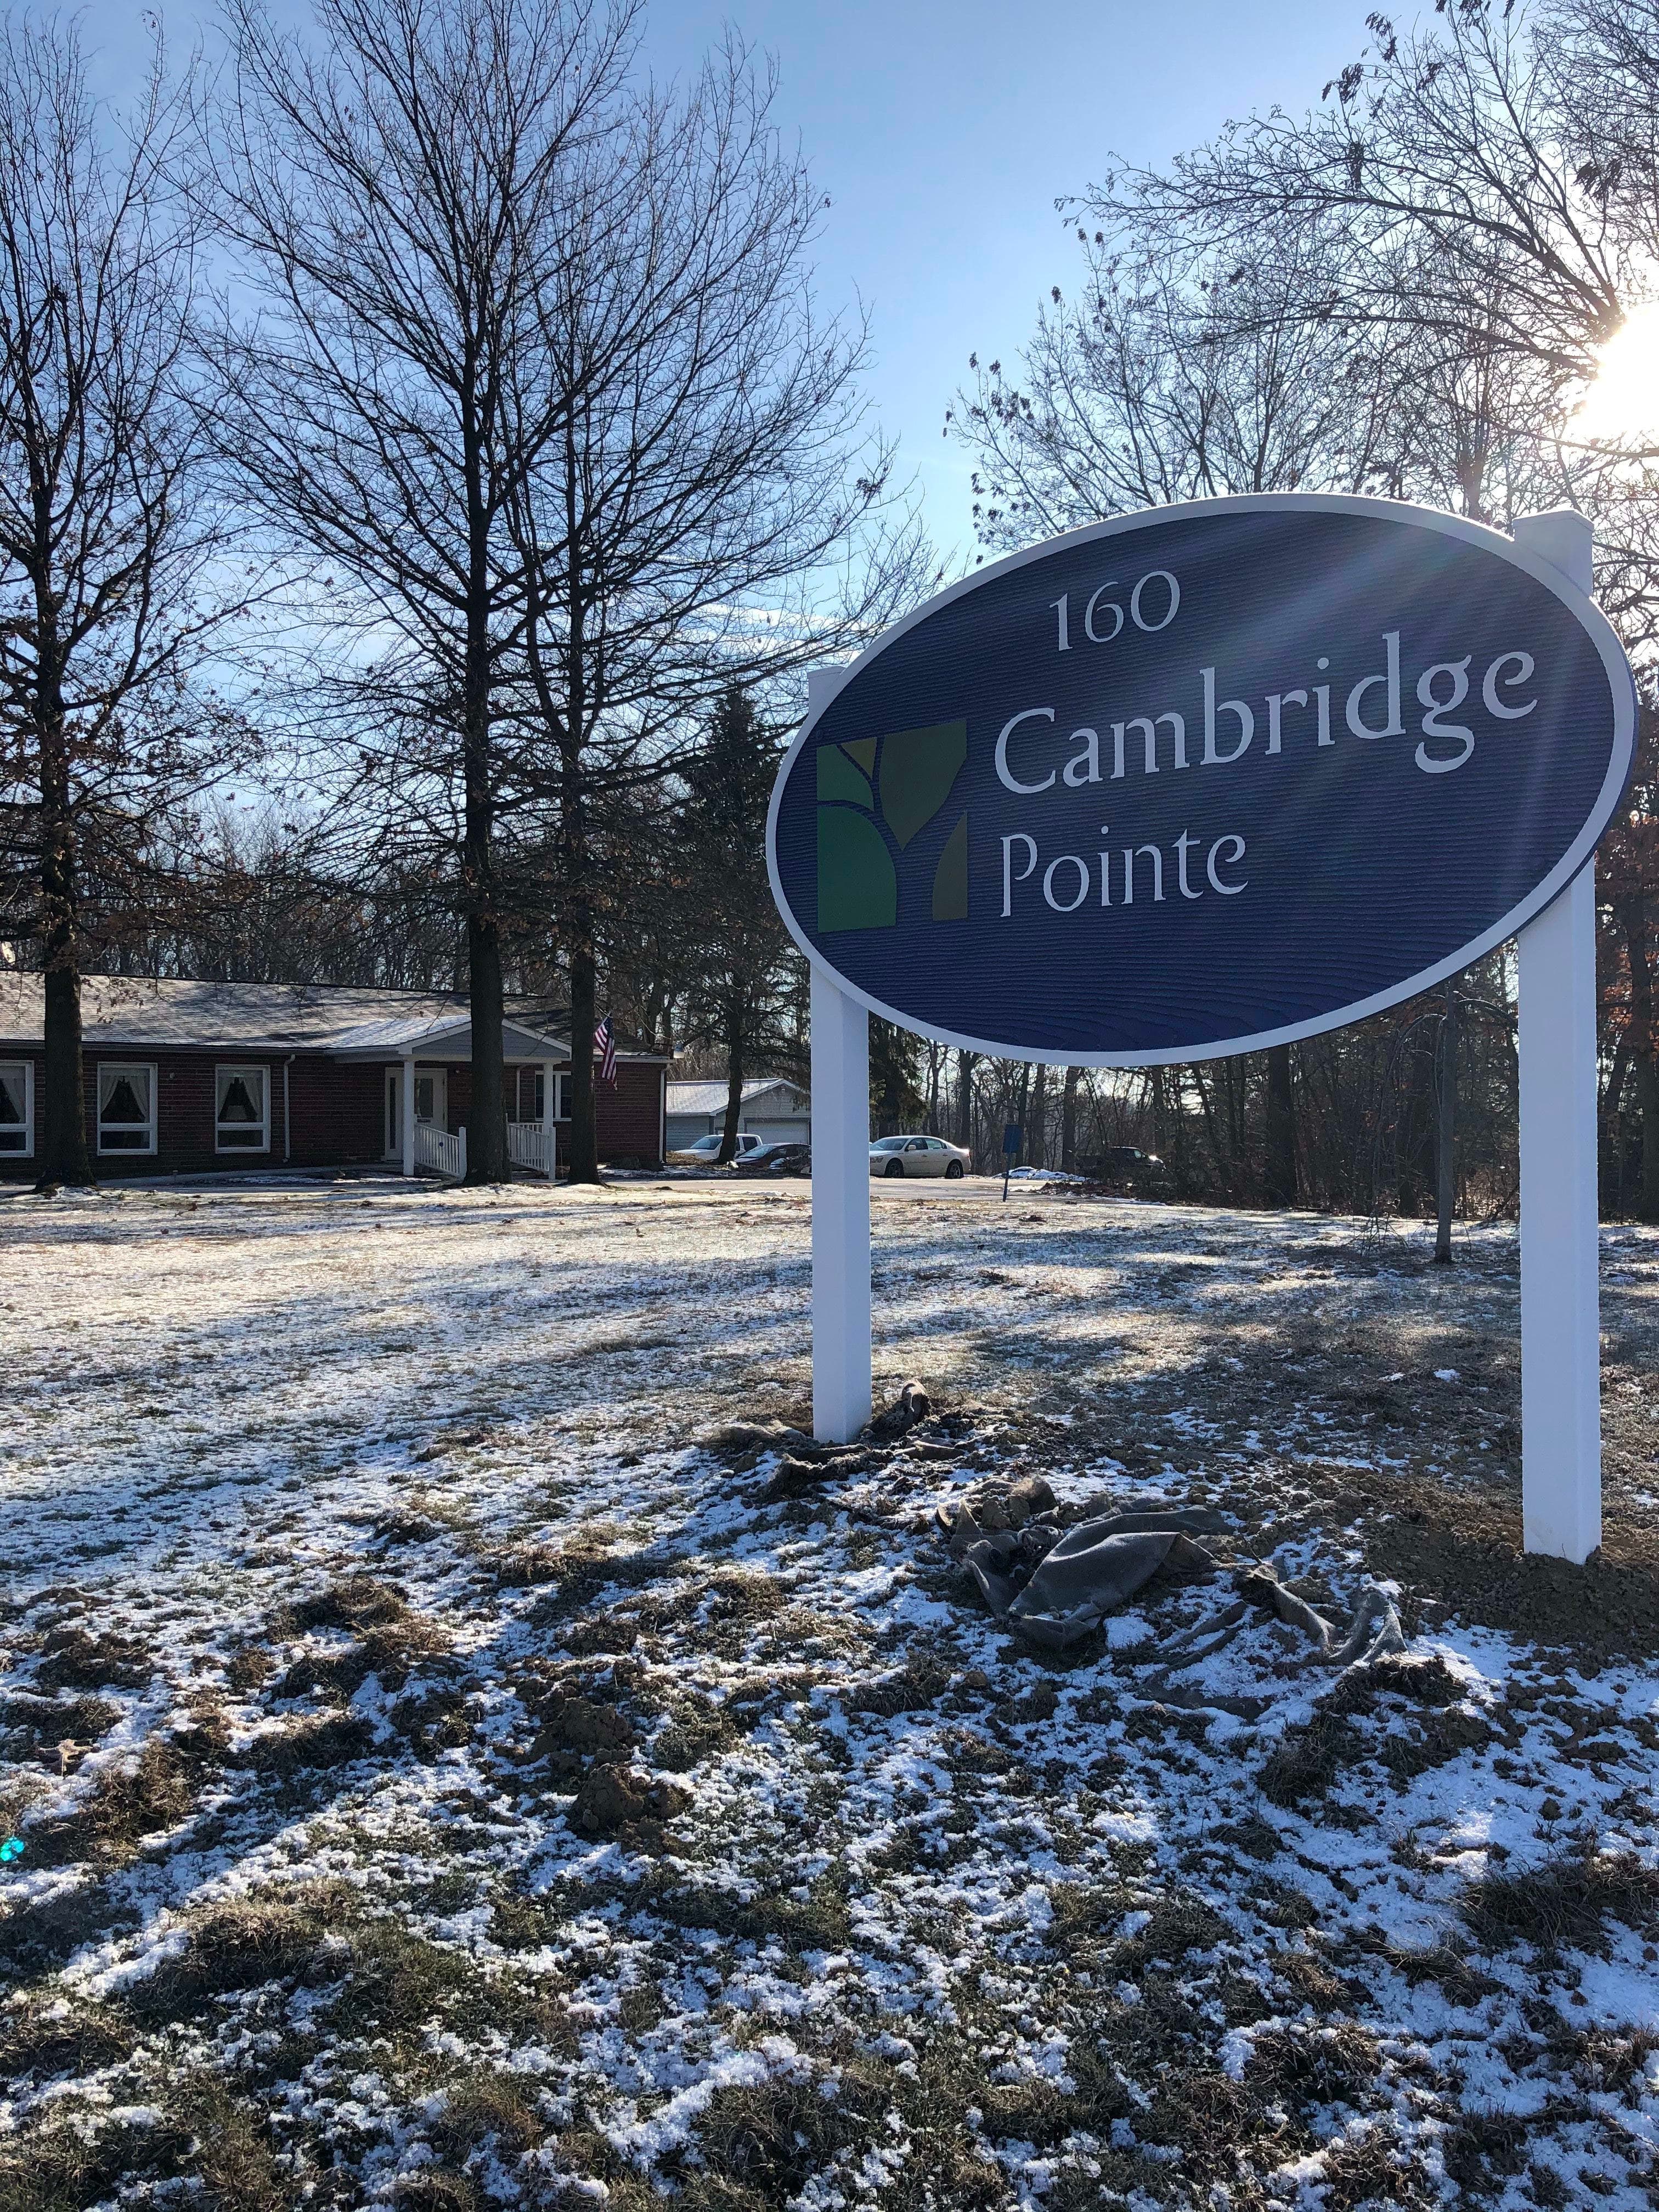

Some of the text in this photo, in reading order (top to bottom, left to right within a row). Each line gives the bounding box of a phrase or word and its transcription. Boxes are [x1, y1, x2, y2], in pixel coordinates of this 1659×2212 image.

[1049, 570, 1181, 651] 160
[995, 630, 1538, 794] Cambridge
[1000, 826, 1249, 918] Pointe
